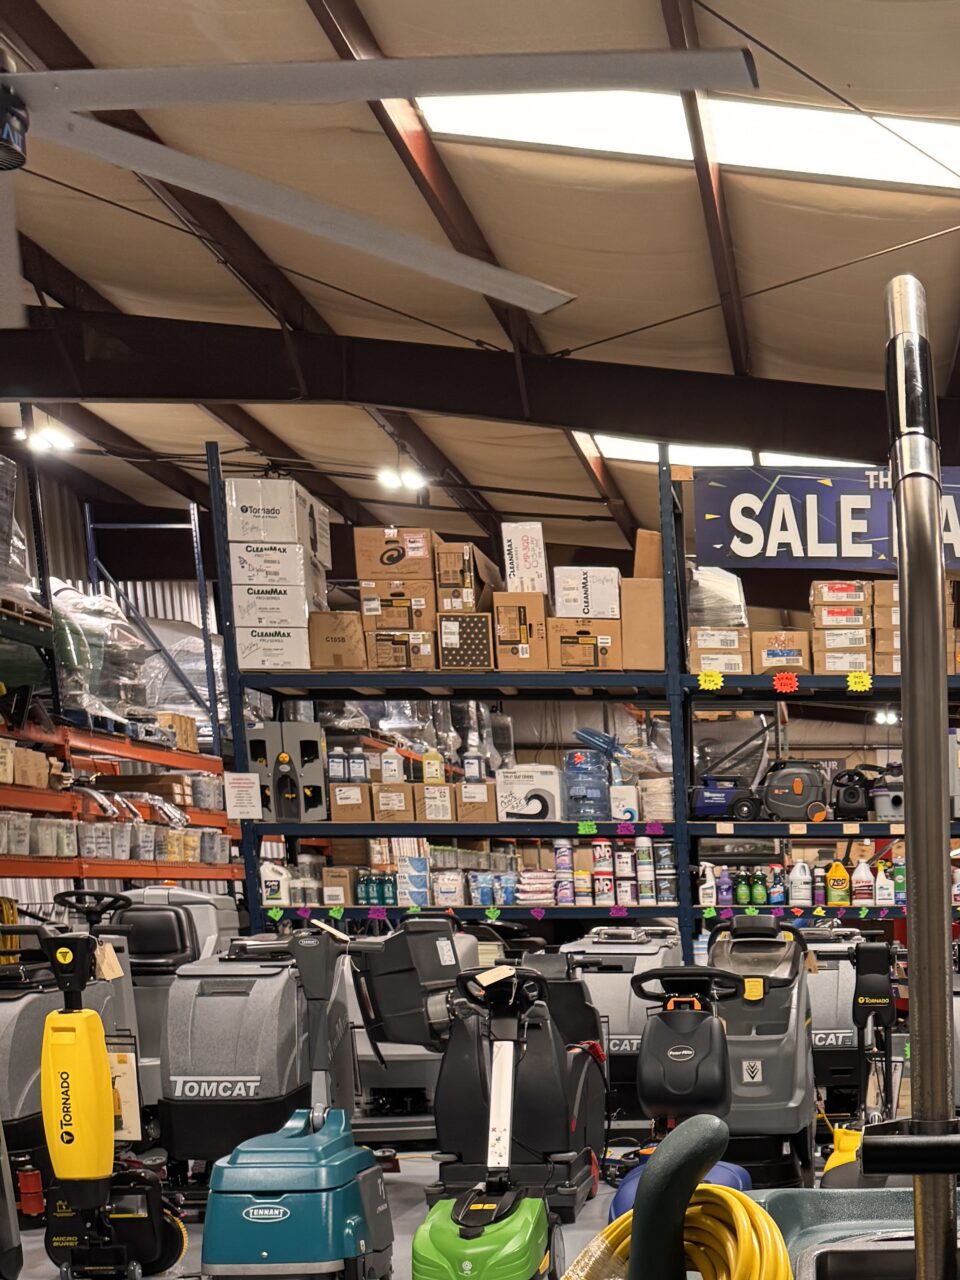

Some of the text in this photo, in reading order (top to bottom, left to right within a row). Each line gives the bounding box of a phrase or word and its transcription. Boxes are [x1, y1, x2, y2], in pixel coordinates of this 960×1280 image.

[865, 471, 892, 489] TH
[249, 506, 280, 515] Tornado
[729, 493, 873, 558] SALE
[251, 630, 292, 638] CLEANMAX
[170, 1076, 261, 1097] TOMCAT
[60, 1072, 72, 1128] TORNADO
[249, 1208, 284, 1218] TENNANT
